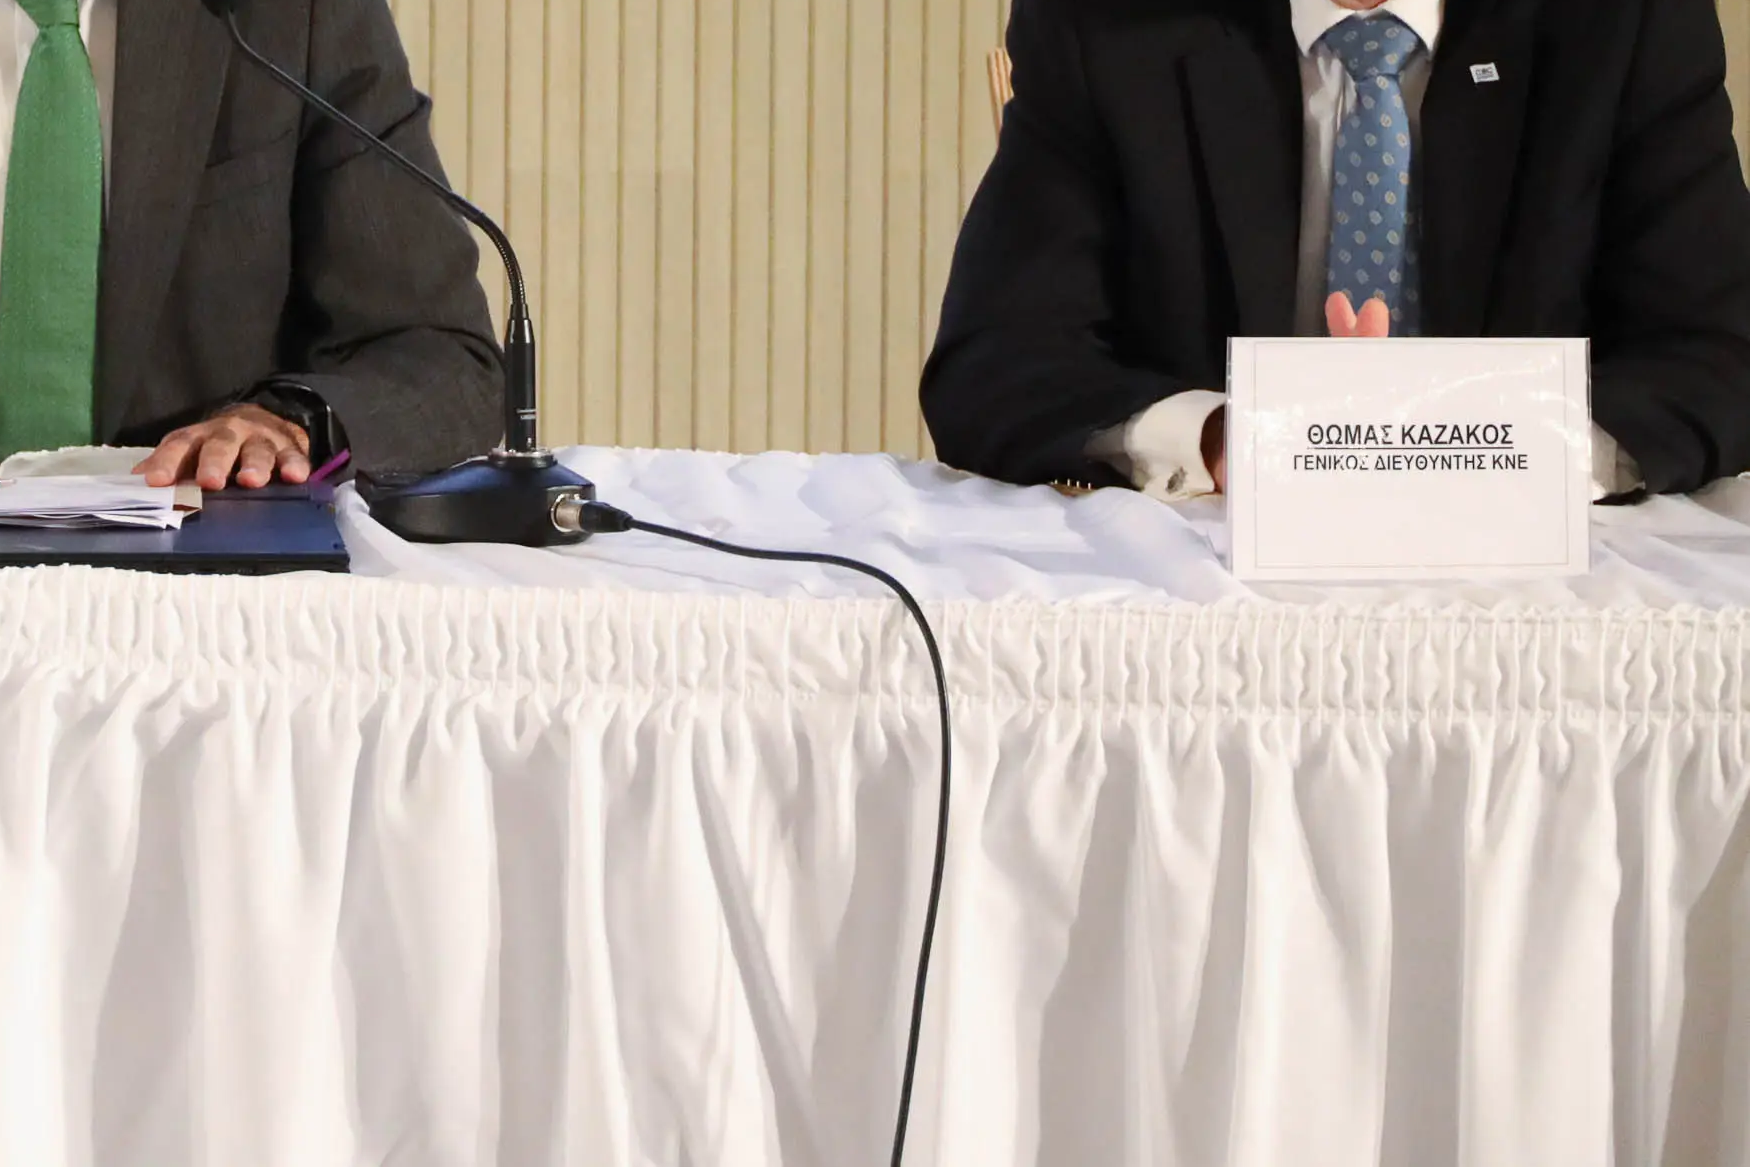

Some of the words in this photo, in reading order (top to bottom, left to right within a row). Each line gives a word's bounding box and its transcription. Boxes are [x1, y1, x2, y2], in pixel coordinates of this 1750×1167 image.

[1307, 424, 1393, 445] ΘΩΜΑΣ
[1401, 424, 1513, 445] ΚΑΖΑΚΟΣ
[1293, 454, 1369, 471] ΓΕΝΙΚΟΣ
[1374, 454, 1487, 471] ΔΙΕΥΘΥΝΤΗΣ
[1493, 454, 1528, 470] ΚΝΕ
